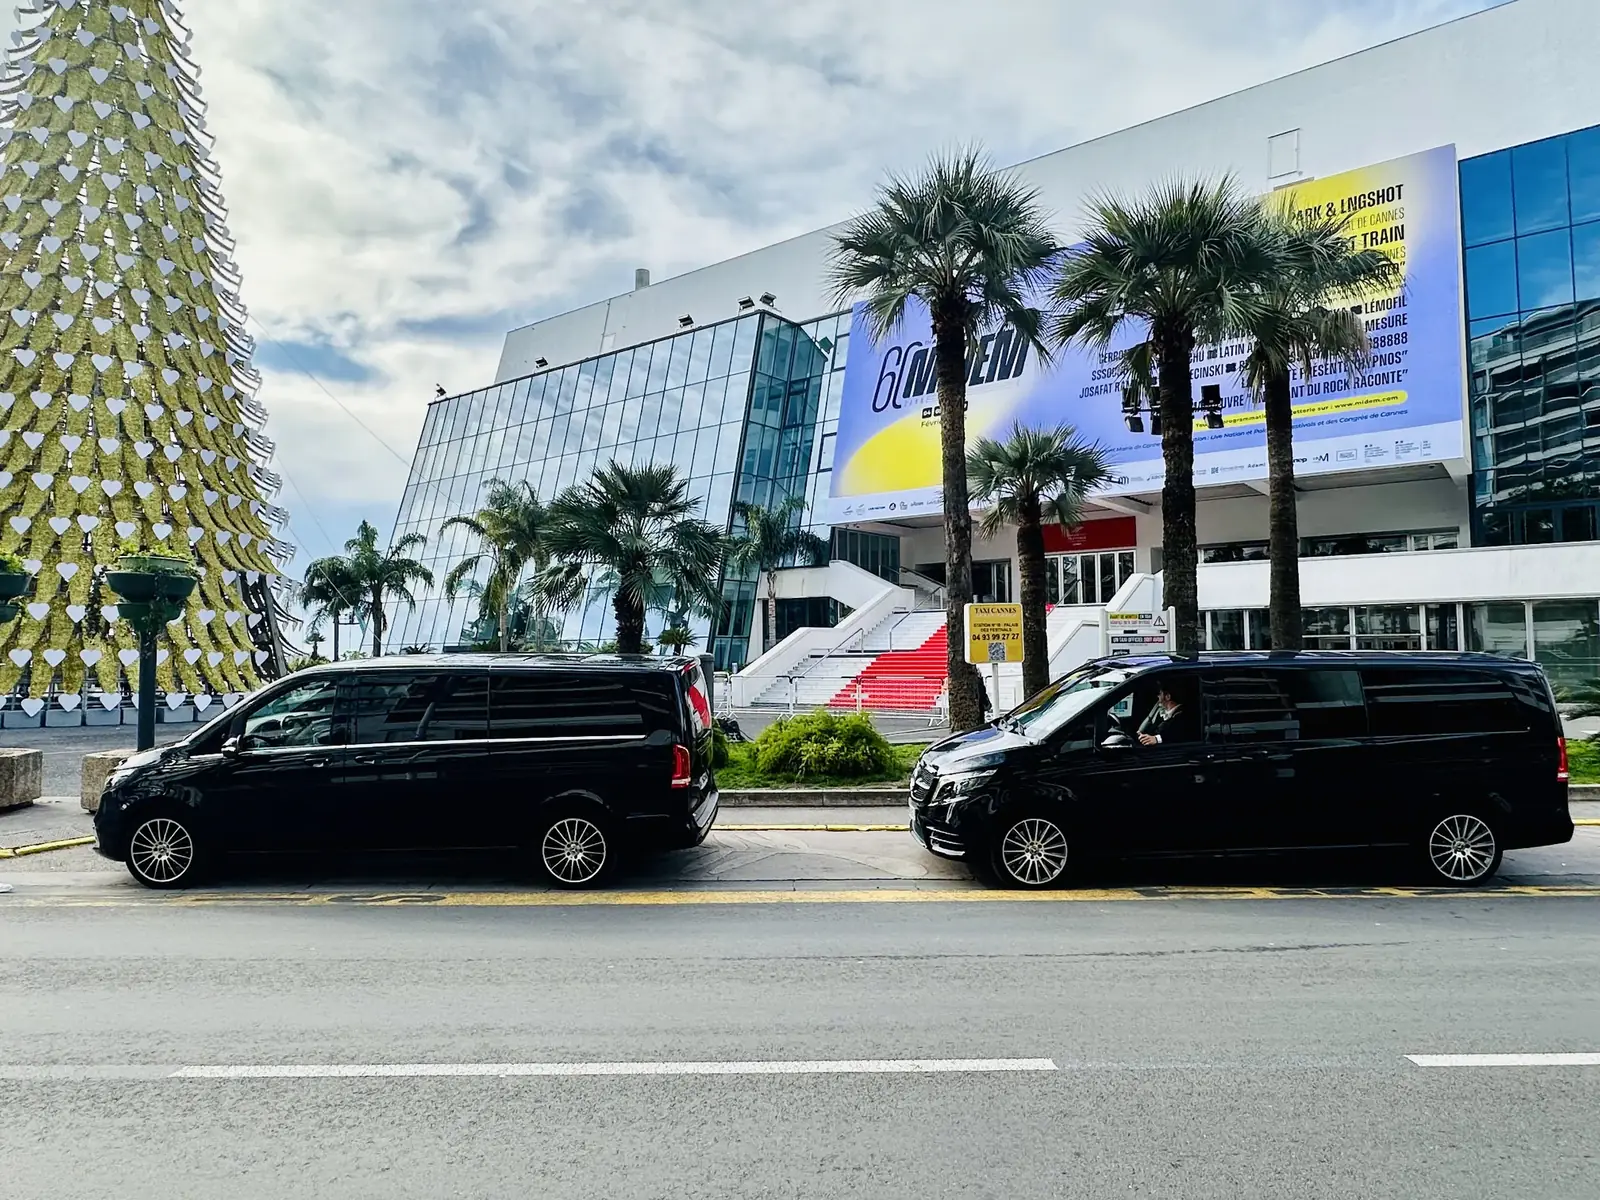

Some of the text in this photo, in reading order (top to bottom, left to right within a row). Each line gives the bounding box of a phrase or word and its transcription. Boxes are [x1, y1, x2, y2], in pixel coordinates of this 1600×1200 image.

[1340, 184, 1404, 214] LNGSHOT
[1357, 217, 1369, 229] DE
[1369, 207, 1405, 226] CANNES
[1361, 224, 1405, 249] TRAIN
[1365, 295, 1408, 314] LÉMOFIL
[1365, 313, 1408, 332] MESURE
[1219, 343, 1245, 359] LATIN
[902, 326, 1032, 398] MEM
[1190, 363, 1224, 380] ECINSKI
[1300, 361, 1349, 379] PÉSENTE
[1079, 382, 1113, 398] JOSAFAT
[1307, 382, 1321, 397] DU
[1323, 377, 1351, 394] ROCK
[1334, 395, 1399, 409] www.midem.com
[921, 418, 942, 428] Févri
[1223, 431, 1245, 439] Nation
[1339, 413, 1369, 424] Congrès
[1380, 408, 1409, 418] Cannes
